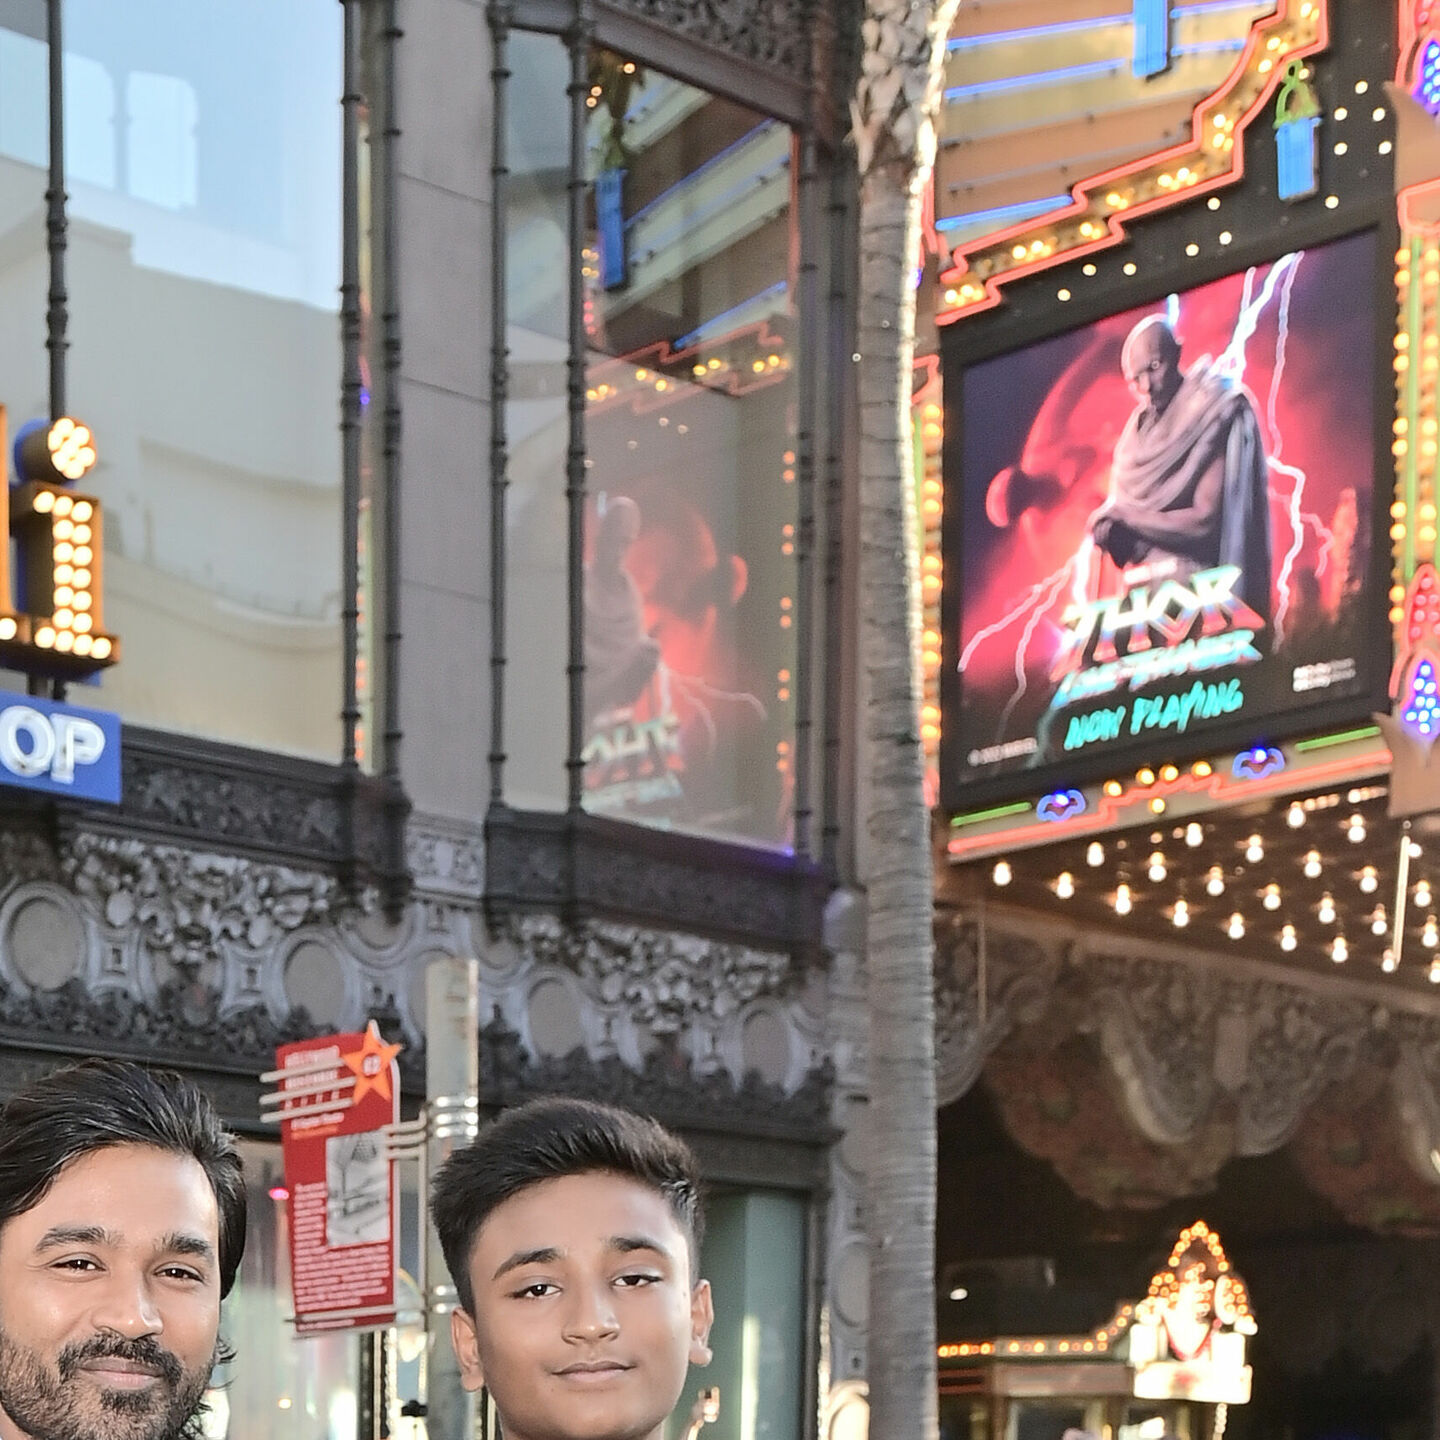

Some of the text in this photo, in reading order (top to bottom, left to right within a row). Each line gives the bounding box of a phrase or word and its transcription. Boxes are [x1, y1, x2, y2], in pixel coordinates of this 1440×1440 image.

[1049, 565, 1267, 683] THOR
[1064, 706, 1127, 751] NOW
[1130, 678, 1244, 736] PLAYING
